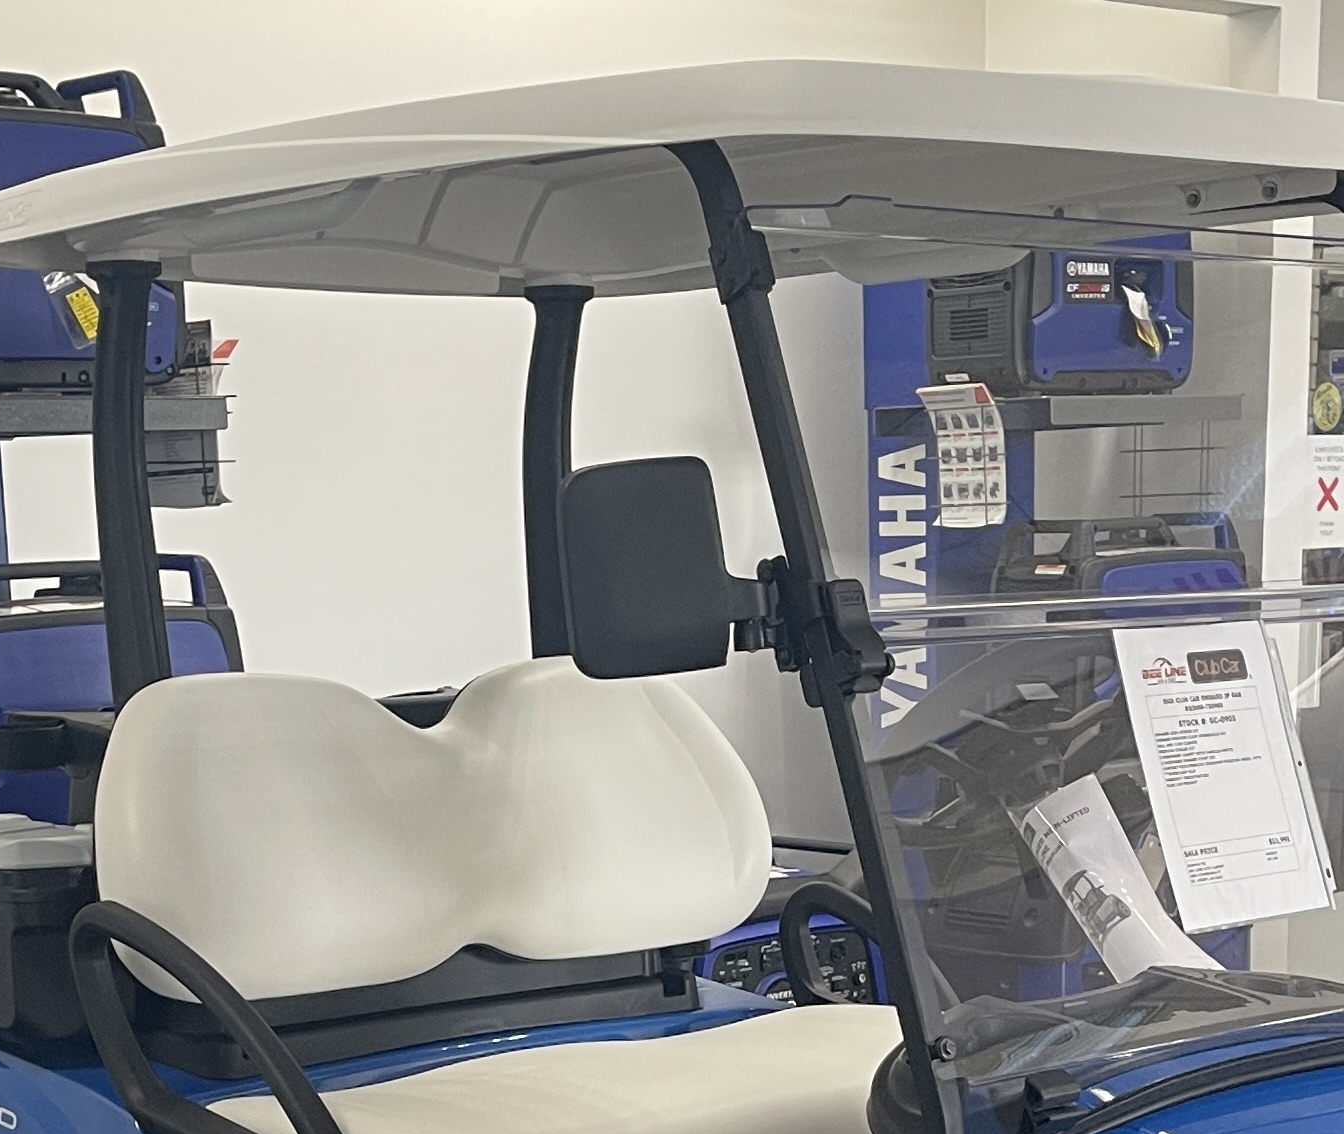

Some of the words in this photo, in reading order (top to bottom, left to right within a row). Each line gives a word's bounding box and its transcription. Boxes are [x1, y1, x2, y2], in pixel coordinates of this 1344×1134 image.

[1077, 263, 1110, 276] YAMAHA
[1142, 668, 1163, 680] BEE
[1165, 666, 1187, 677] LINE
